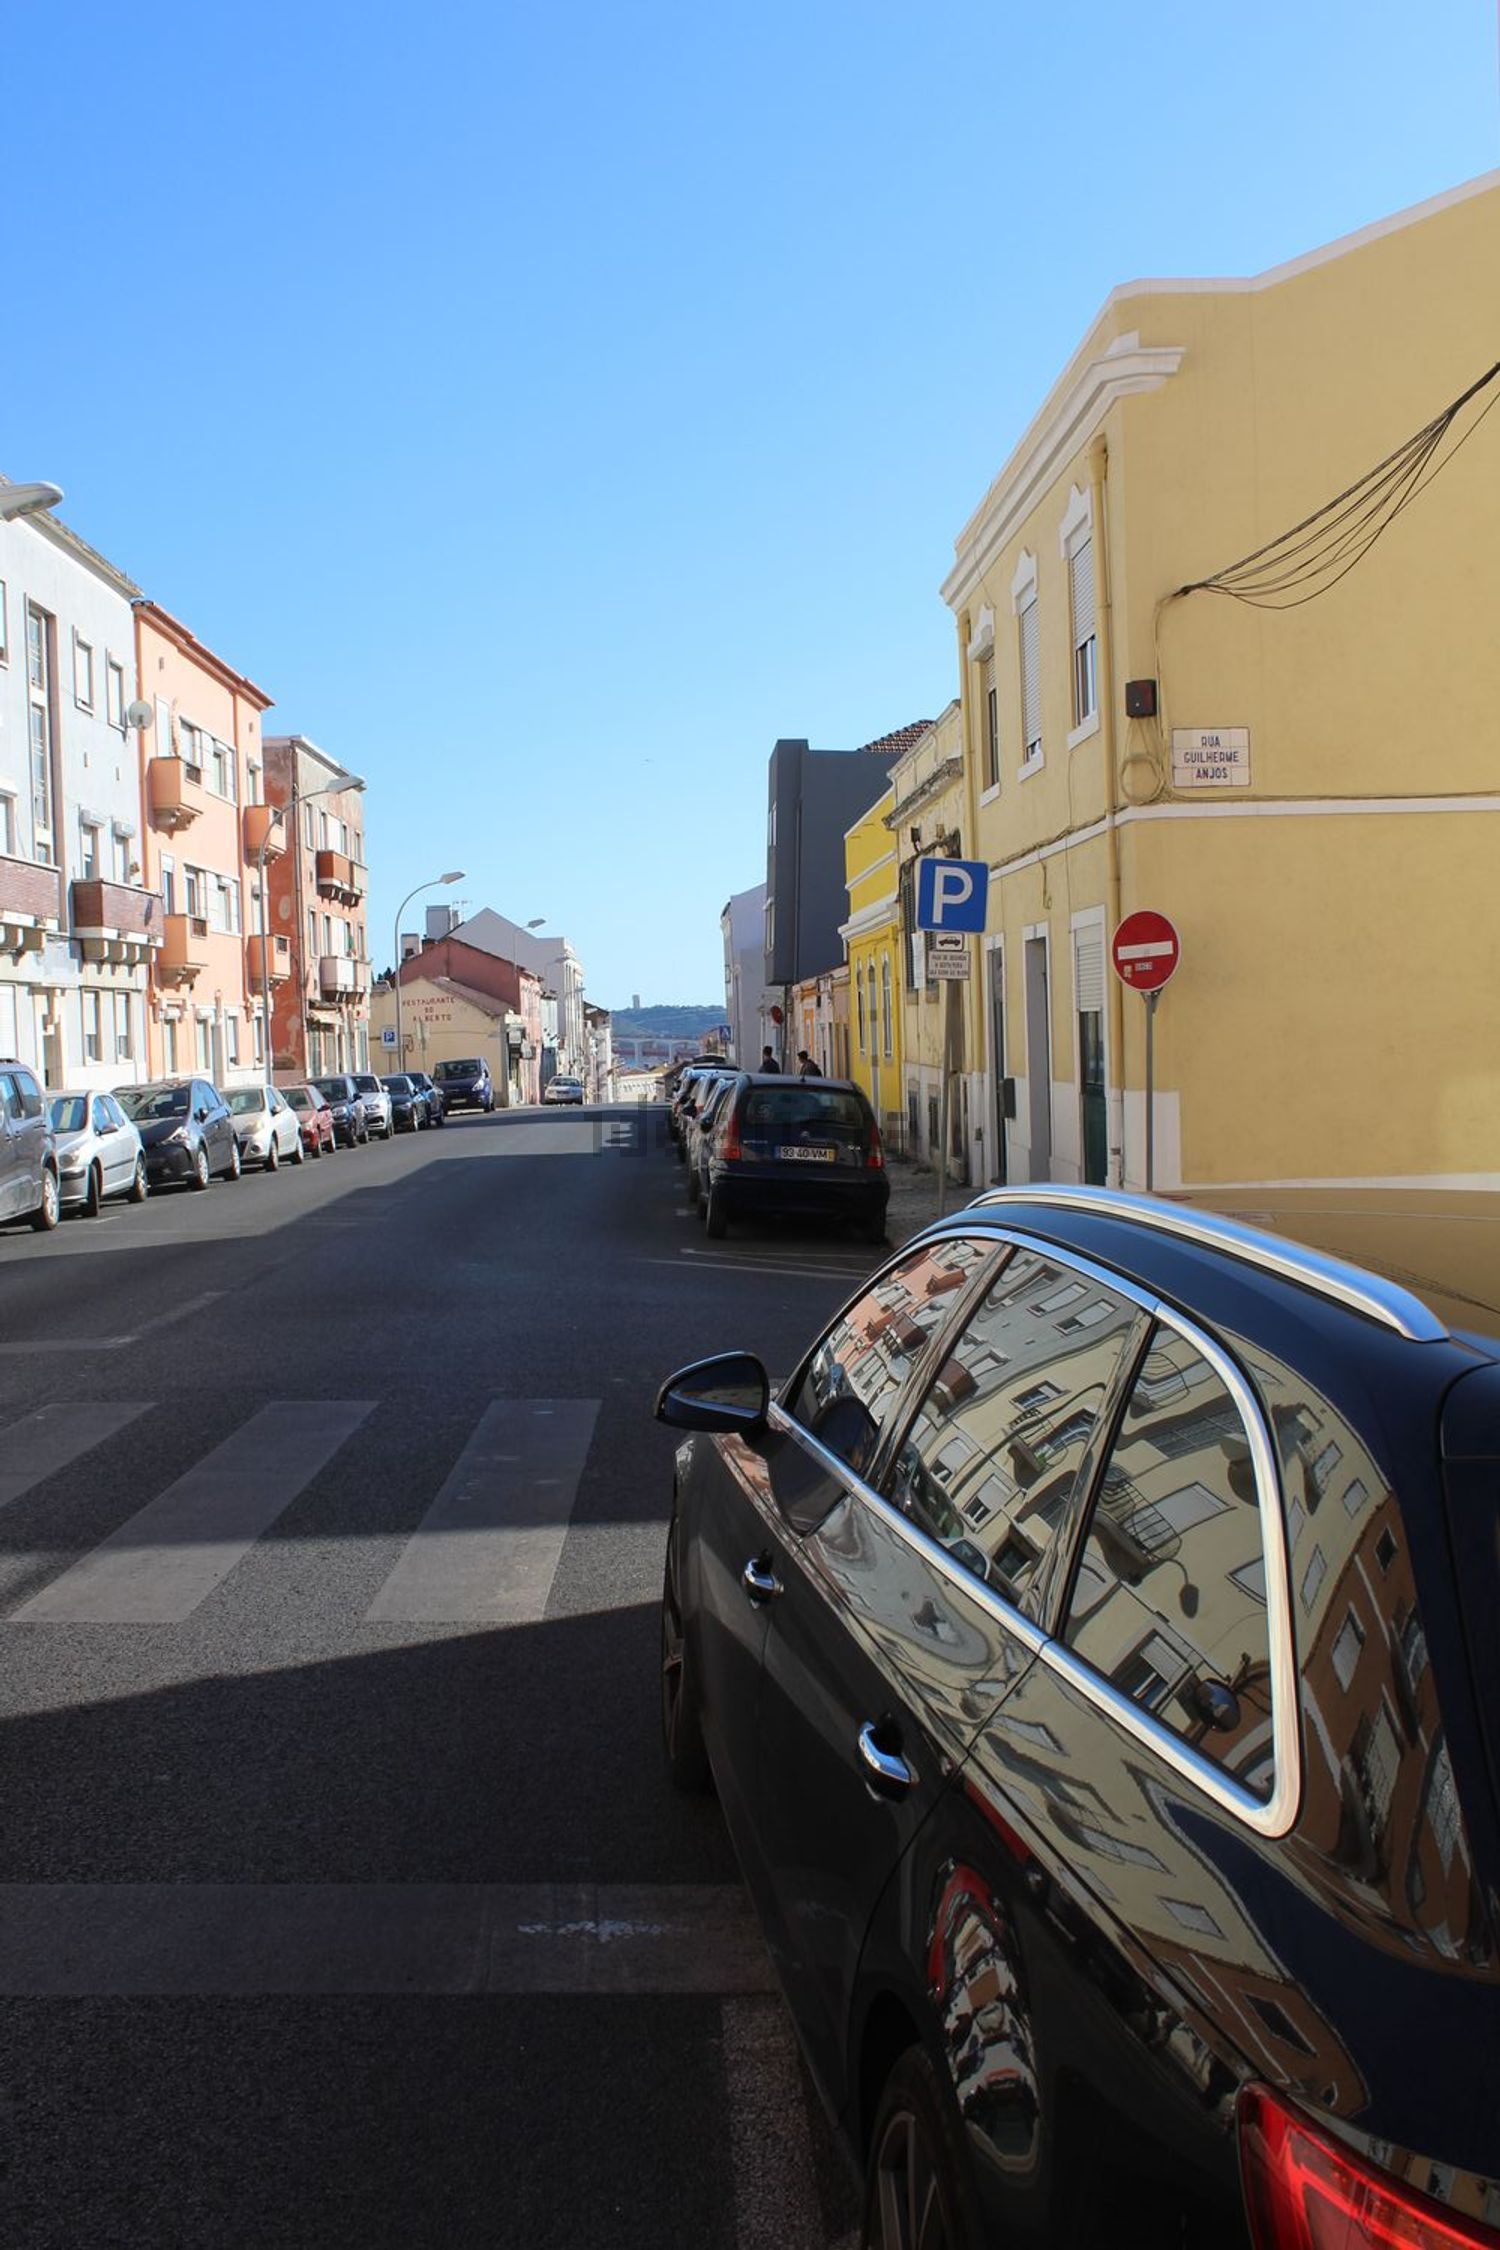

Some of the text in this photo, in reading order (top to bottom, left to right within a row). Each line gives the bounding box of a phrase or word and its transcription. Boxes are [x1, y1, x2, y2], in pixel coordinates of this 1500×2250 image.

[1201, 736, 1221, 747] RUA
[1183, 751, 1240, 763] GUILHERME
[1195, 768, 1228, 779] ANJOS
[932, 865, 973, 924] P
